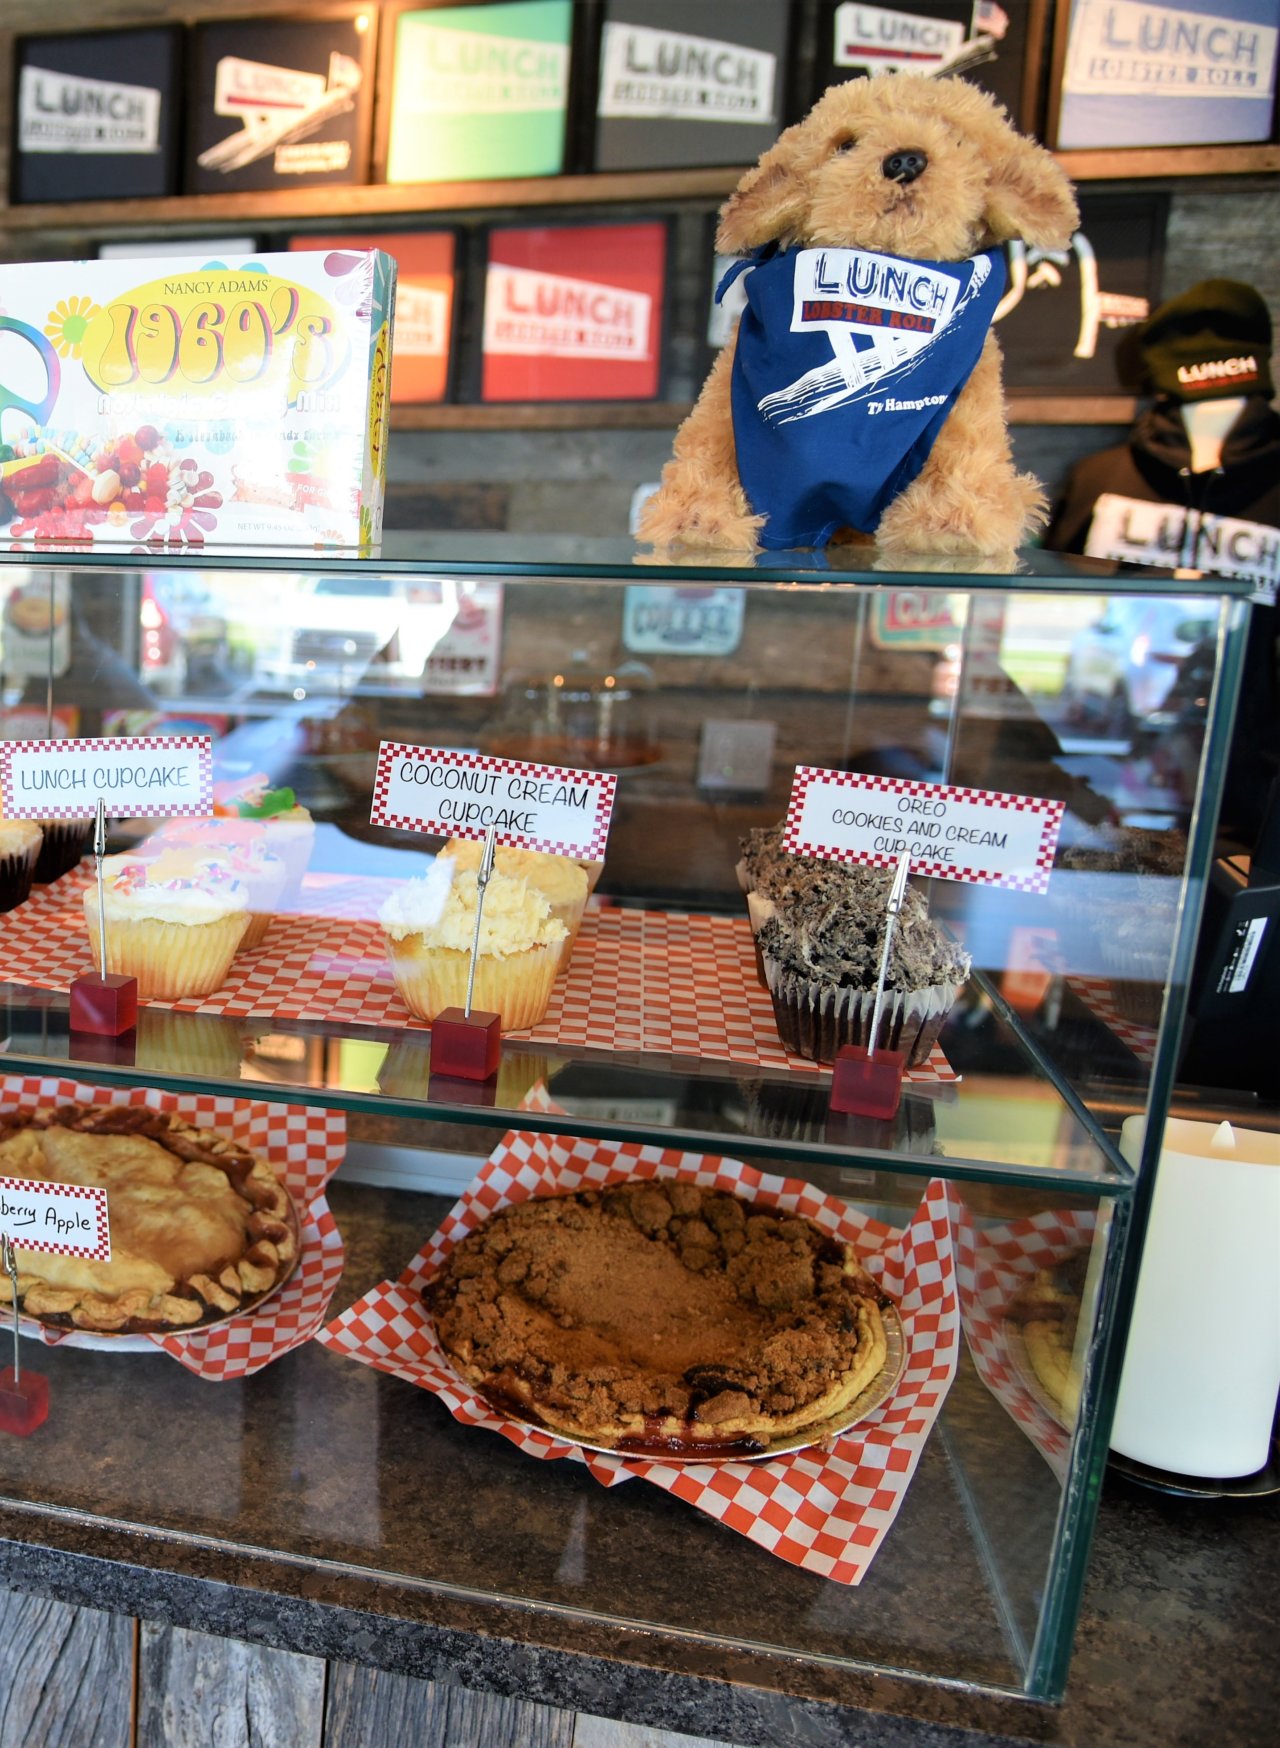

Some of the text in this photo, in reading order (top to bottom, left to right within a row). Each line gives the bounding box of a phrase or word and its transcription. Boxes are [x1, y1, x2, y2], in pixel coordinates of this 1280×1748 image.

[854, 12, 952, 49] LUNCH
[1102, 7, 1259, 68] LUNCH
[428, 34, 561, 77] LUNCH
[625, 36, 758, 90] LUNCH
[33, 77, 145, 121] LUNCH
[164, 282, 214, 295] NANCY
[506, 276, 636, 328] LUNCH
[813, 252, 949, 316] LUNCH
[99, 286, 332, 386] 1960's
[803, 301, 935, 333] LOBSTER ROLL
[1178, 356, 1258, 385] LUNCH
[1119, 507, 1279, 568] LUNCH
[21, 766, 190, 790] LUNCH CUPCAKE
[400, 761, 589, 810] COCONUT CREAM
[438, 798, 538, 834] CUPCAKE
[897, 797, 947, 818] OREO
[832, 809, 1008, 849] COOKIES AND CREAM
[44, 1207, 91, 1235] Apple
